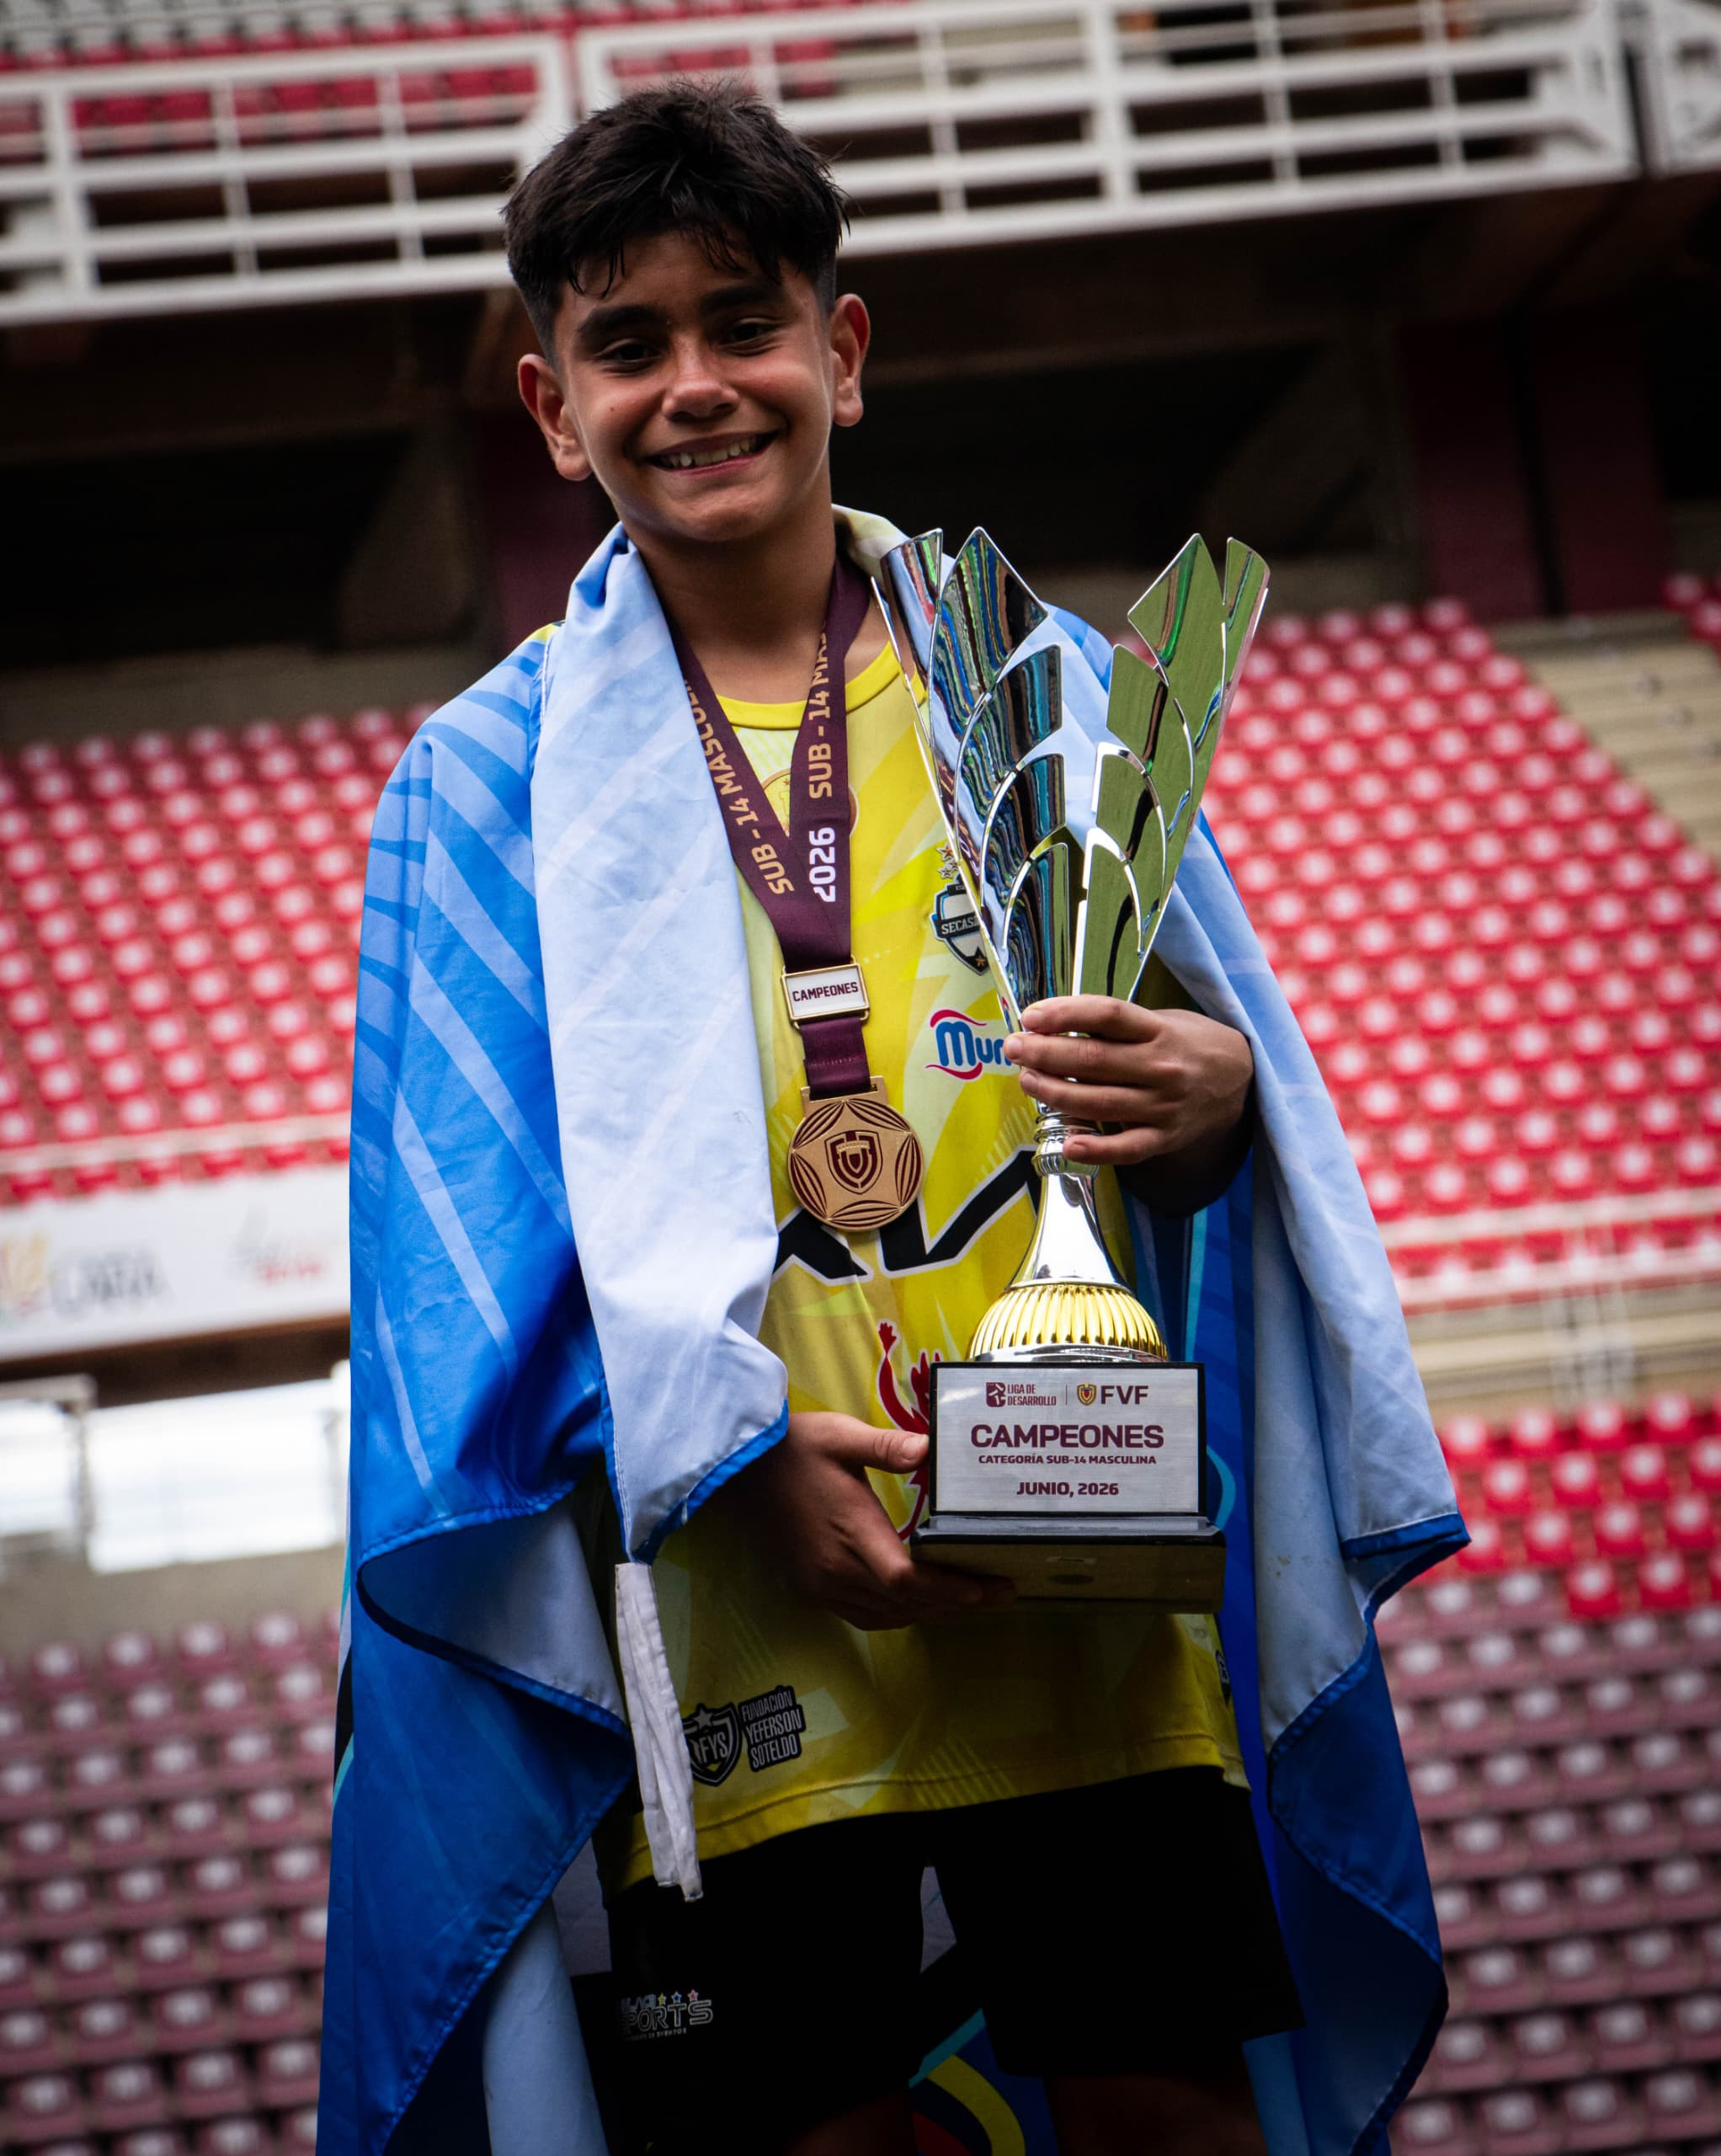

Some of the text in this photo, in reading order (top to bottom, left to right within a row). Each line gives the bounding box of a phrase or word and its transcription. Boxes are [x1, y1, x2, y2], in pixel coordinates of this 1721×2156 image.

[808, 690, 830, 721] 14
[808, 743, 833, 799] SUB
[729, 797, 759, 825] 14
[751, 843, 795, 895] SUB
[808, 827, 836, 903] 2026
[792, 982, 858, 1002] CAMPEONES
[935, 1022, 1013, 1067] Mun
[1007, 1384, 1036, 1395] LIGA DE
[1007, 1396, 1057, 1406] DESARROLLO
[1100, 1385, 1148, 1405] FVF
[971, 1424, 1164, 1448] CAMPEONES
[978, 1453, 1157, 1465] CATEGORÍA SUB-14 MASCULINA
[1016, 1482, 1119, 1497] JUNIO, 2026
[745, 1709, 802, 1746] YEFERSON
[750, 1733, 798, 1769] SOTELDO
